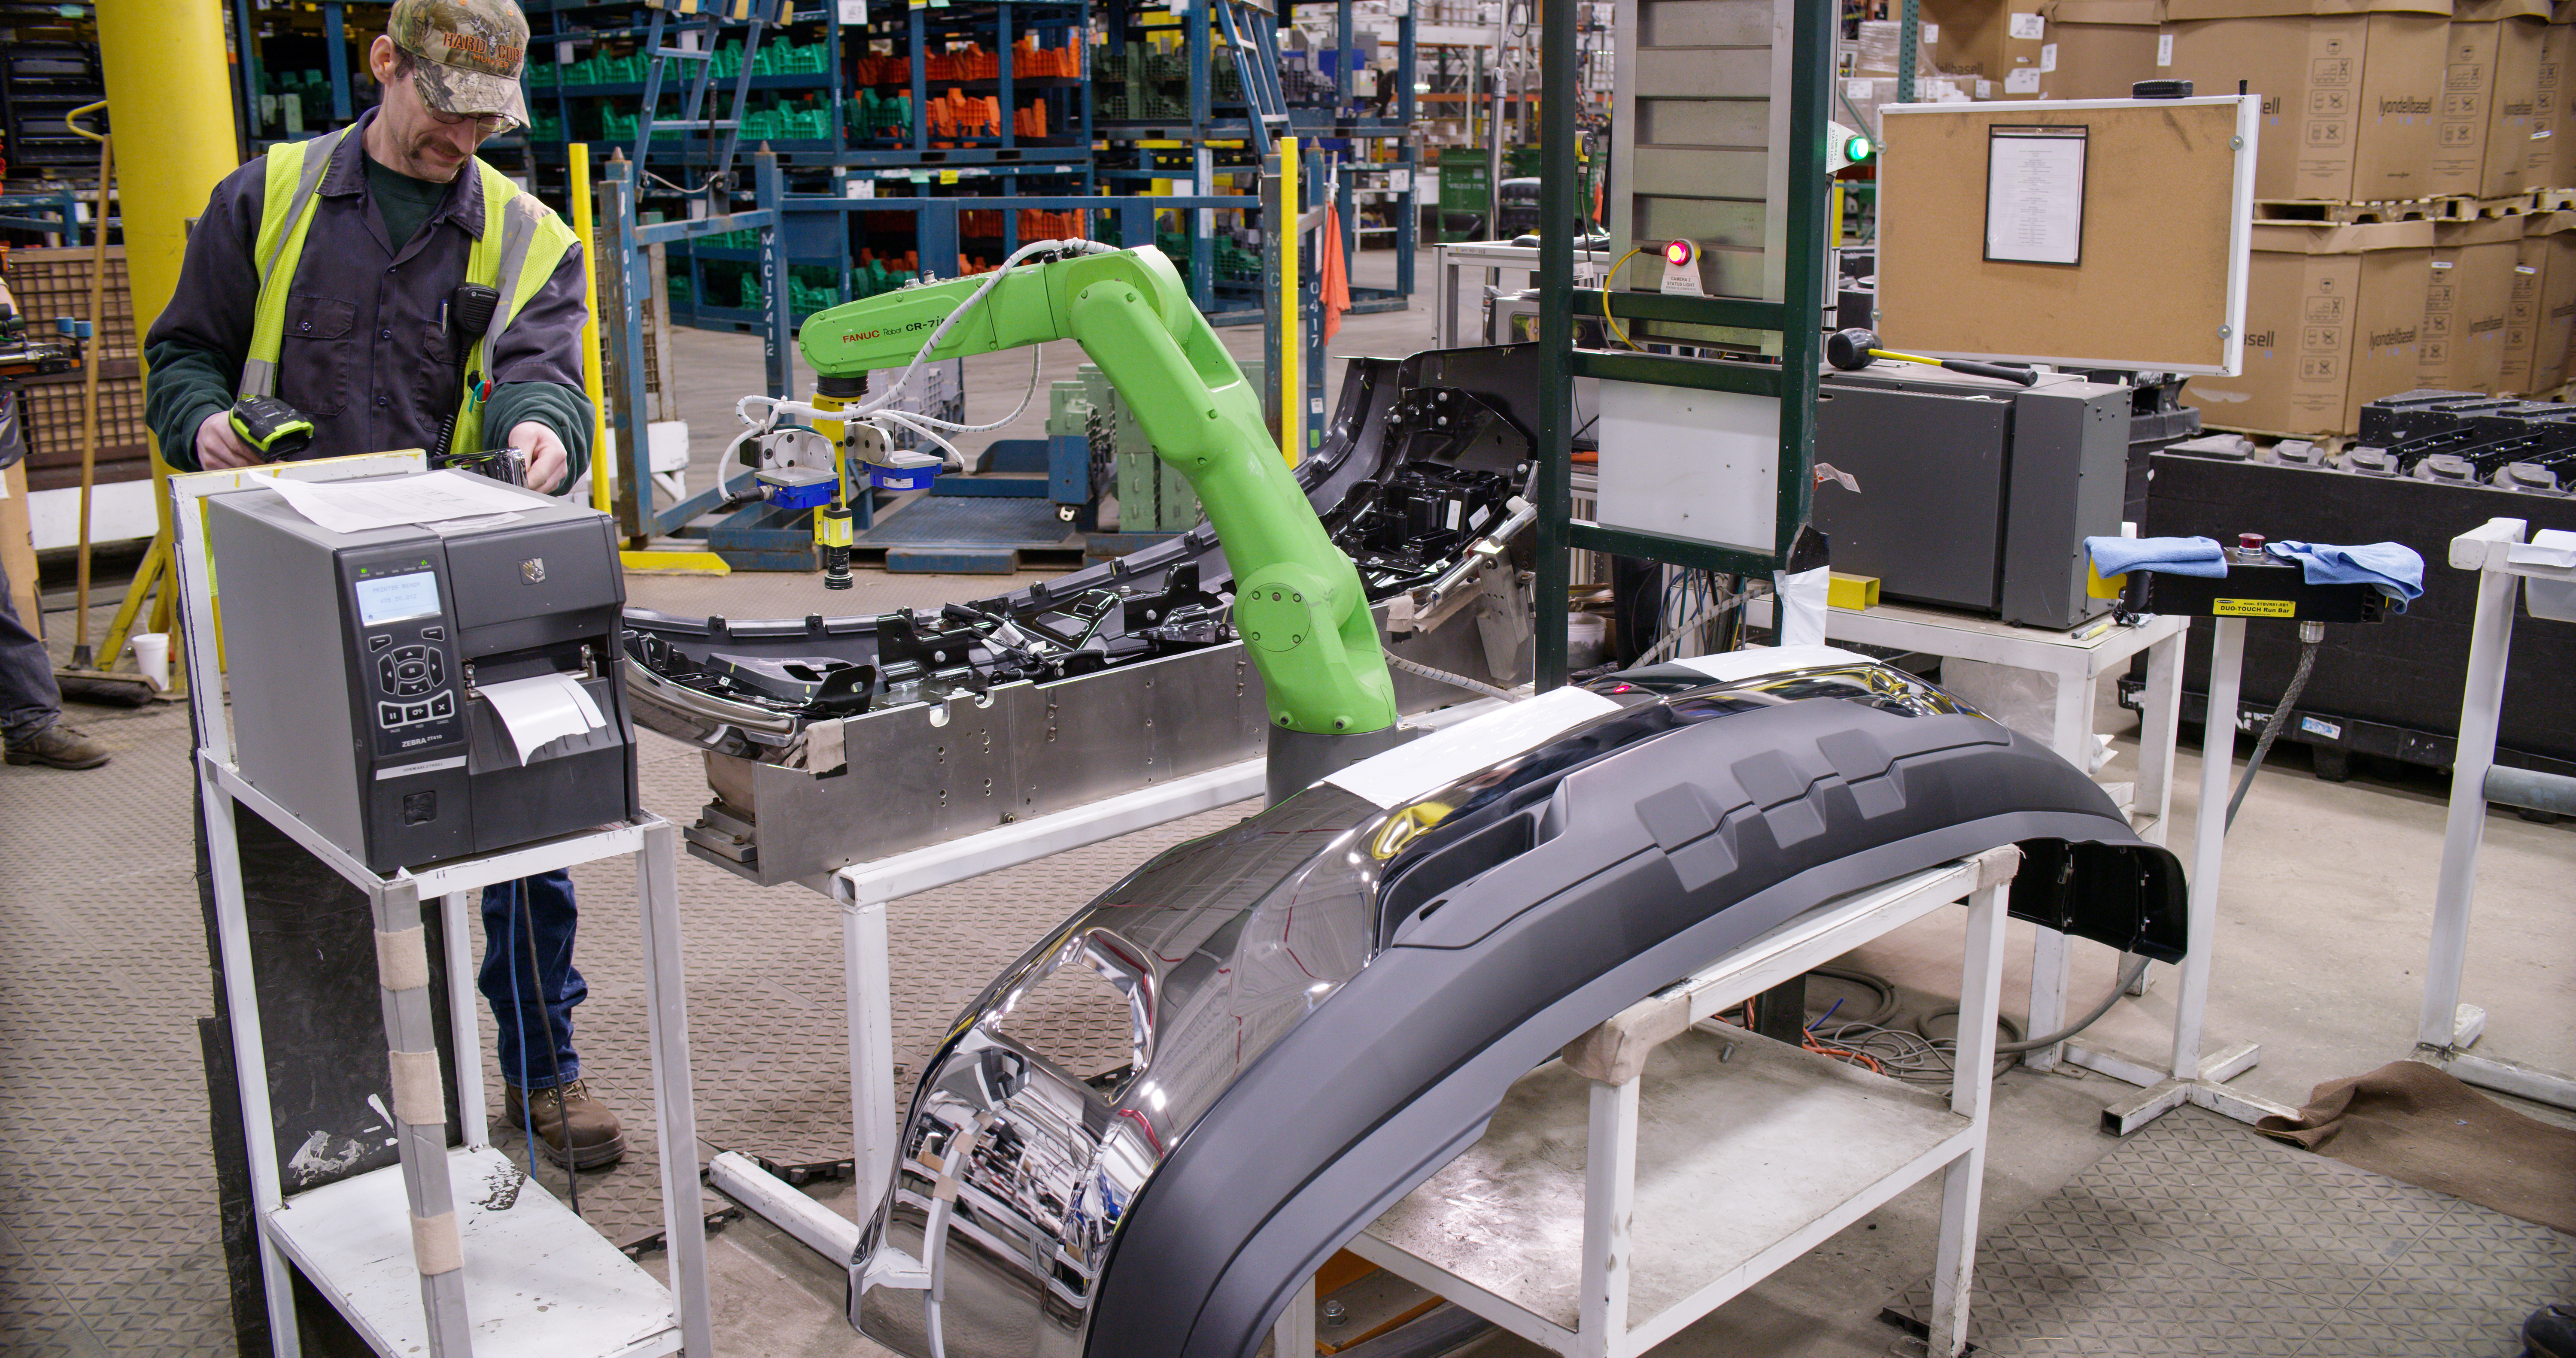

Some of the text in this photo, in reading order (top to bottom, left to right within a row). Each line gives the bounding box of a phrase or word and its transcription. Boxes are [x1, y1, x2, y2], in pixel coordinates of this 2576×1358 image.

[443, 32, 487, 54] HARD
[473, 53, 509, 68] HUNTER
[843, 330, 880, 343] FANUC
[883, 327, 902, 336] Robot
[373, 585, 399, 593] PRINTER
[380, 594, 417, 603] V75.20.01Z
[401, 738, 427, 747] ZEBRA
